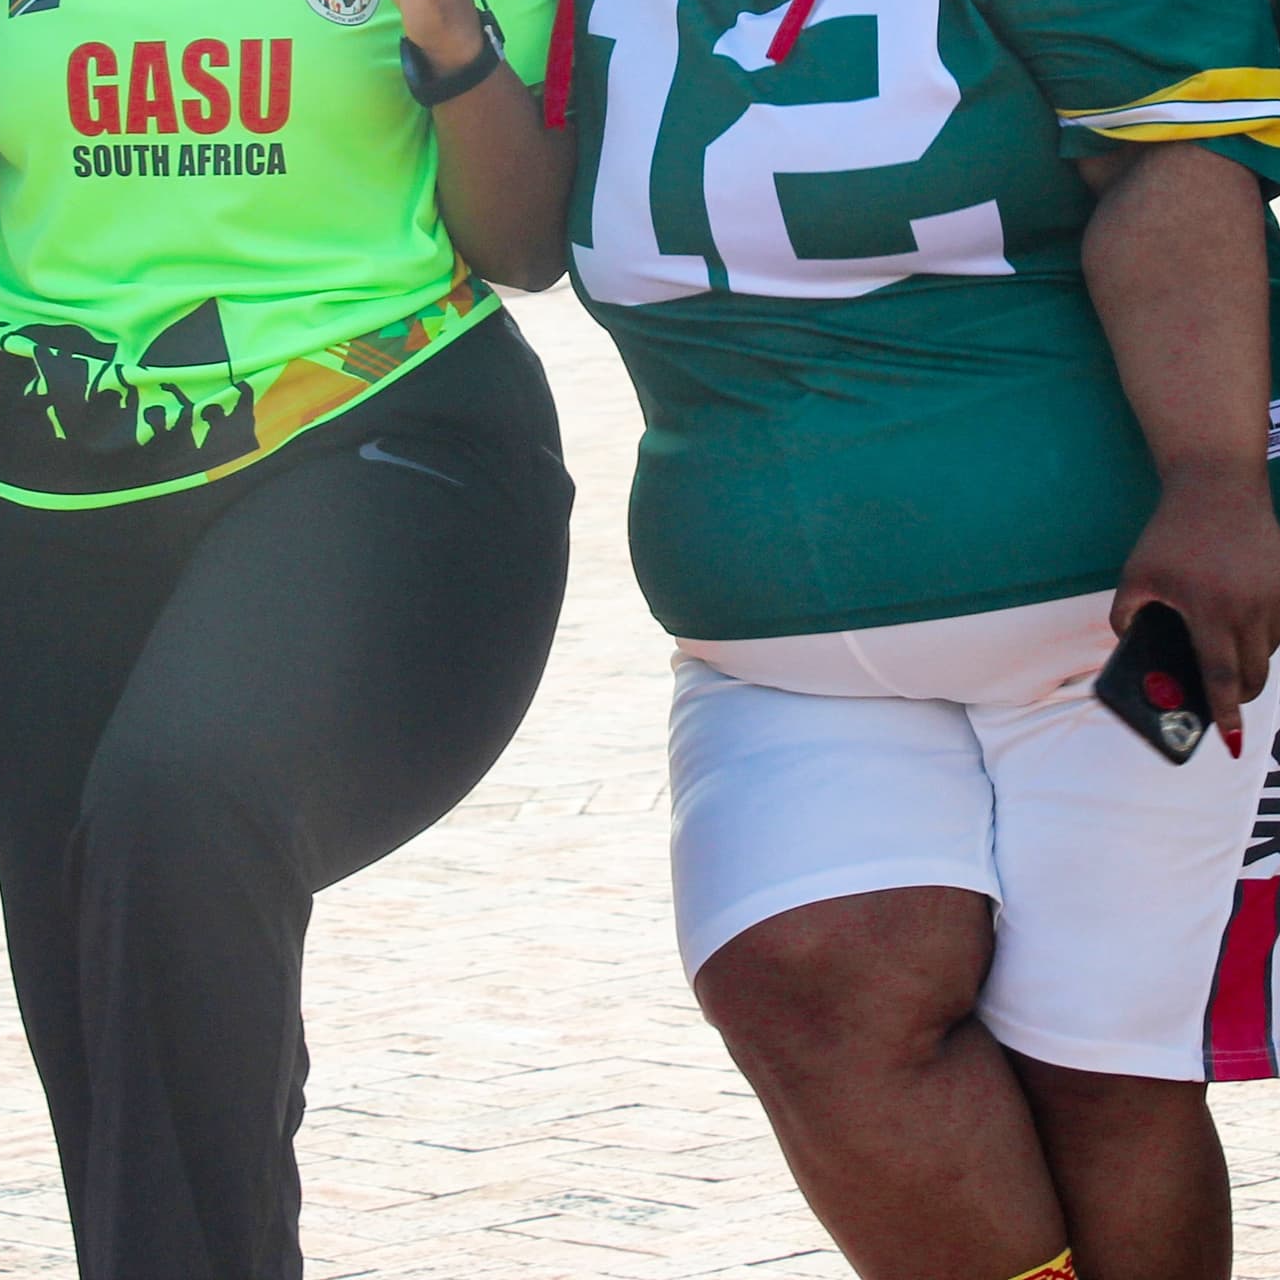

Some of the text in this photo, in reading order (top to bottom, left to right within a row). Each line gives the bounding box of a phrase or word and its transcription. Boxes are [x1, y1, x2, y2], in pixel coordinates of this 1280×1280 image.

[66, 38, 293, 137] GASU
[73, 142, 287, 178] SOUTH AFRICA
